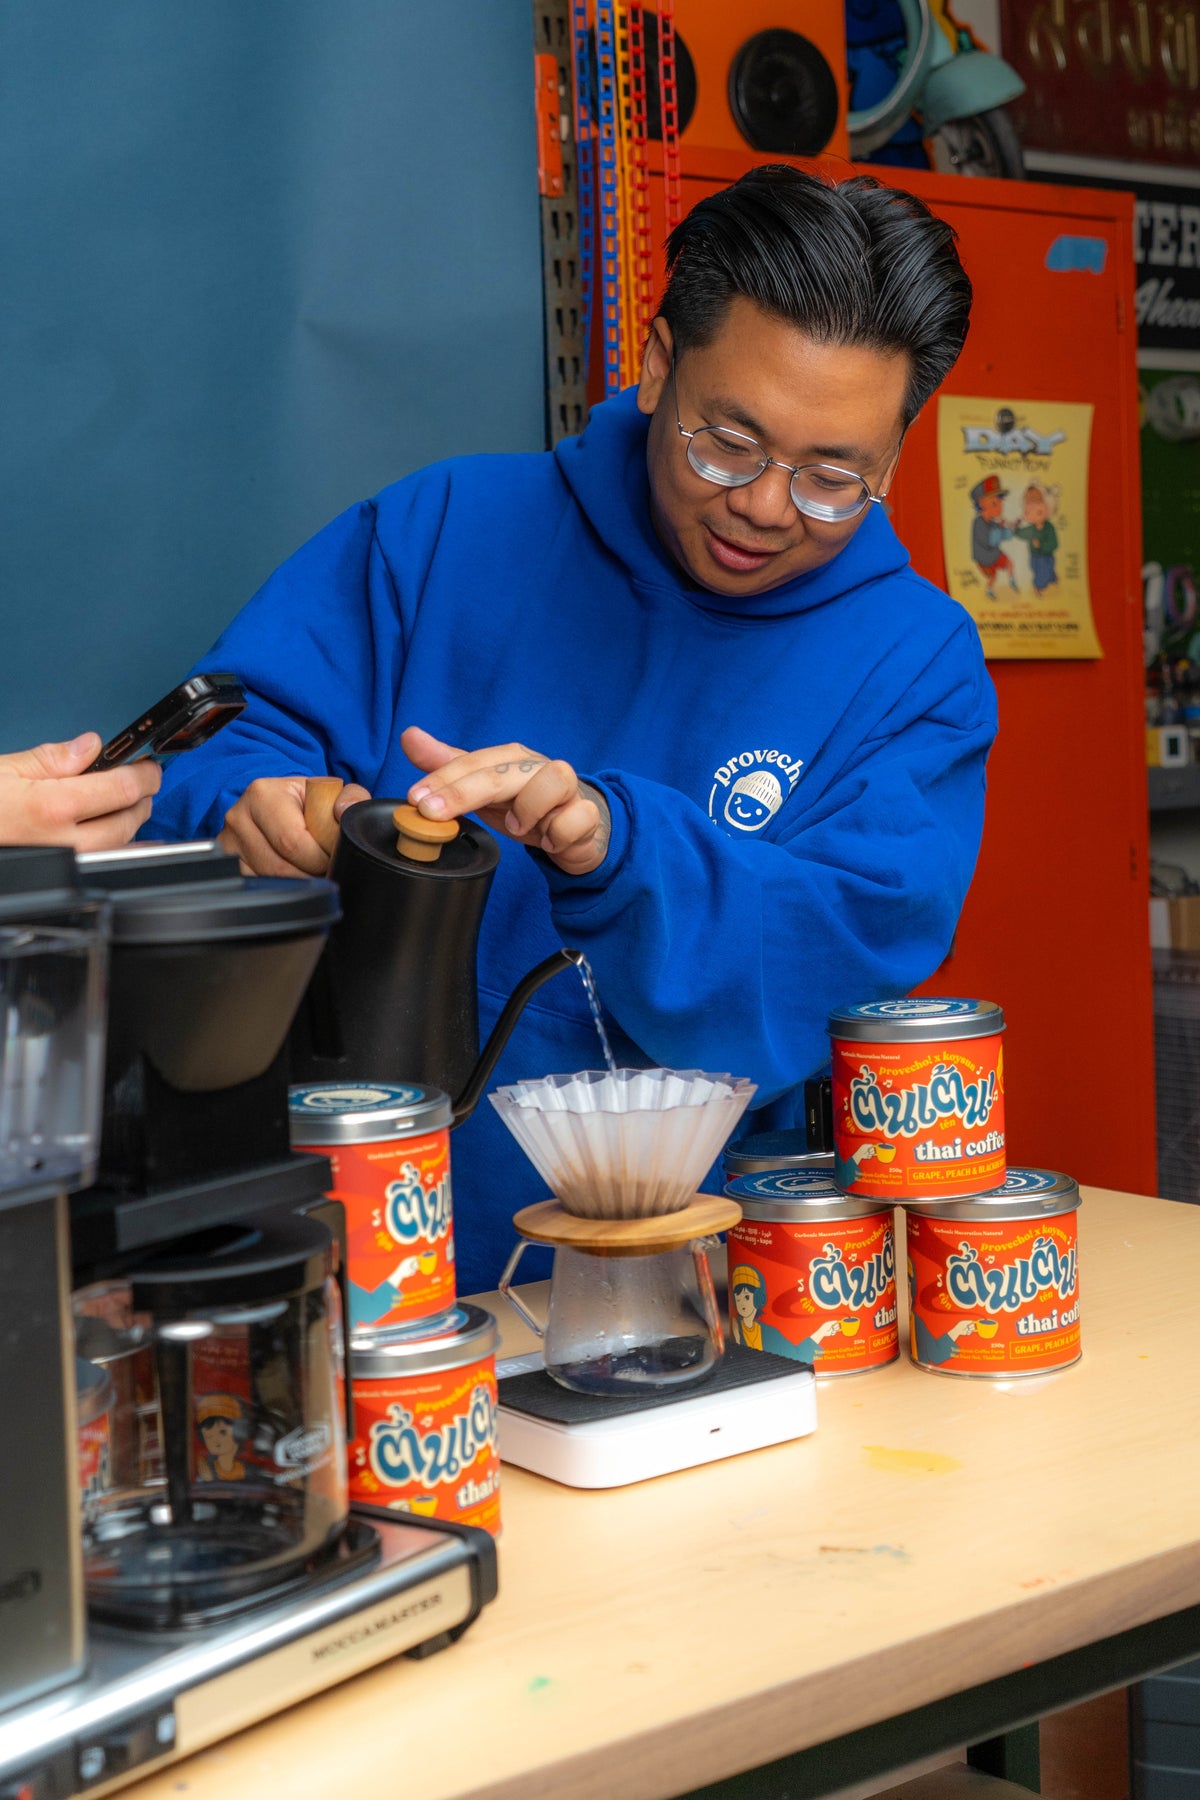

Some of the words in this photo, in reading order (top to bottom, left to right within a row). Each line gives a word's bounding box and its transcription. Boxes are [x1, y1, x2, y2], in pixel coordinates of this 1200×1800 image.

[714, 750, 804, 793] provech
[879, 1055, 933, 1077] provecho!
[934, 1055, 941, 1063] x
[942, 1050, 976, 1072] koysun
[914, 1137, 962, 1162] thai
[913, 1170, 945, 1181] GRAPE,
[945, 1168, 971, 1179] PEACH
[972, 1166, 978, 1176] &
[844, 1223, 887, 1251] provecho!
[980, 1228, 1033, 1252] provecho!
[1034, 1228, 1041, 1236] x
[1041, 1224, 1068, 1244] koysun
[874, 1300, 897, 1328] thai
[1016, 1309, 1059, 1336] thai
[1014, 1344, 1044, 1354] GRAPE,
[1045, 1337, 1065, 1349] PEACH
[457, 1469, 494, 1508] thai
